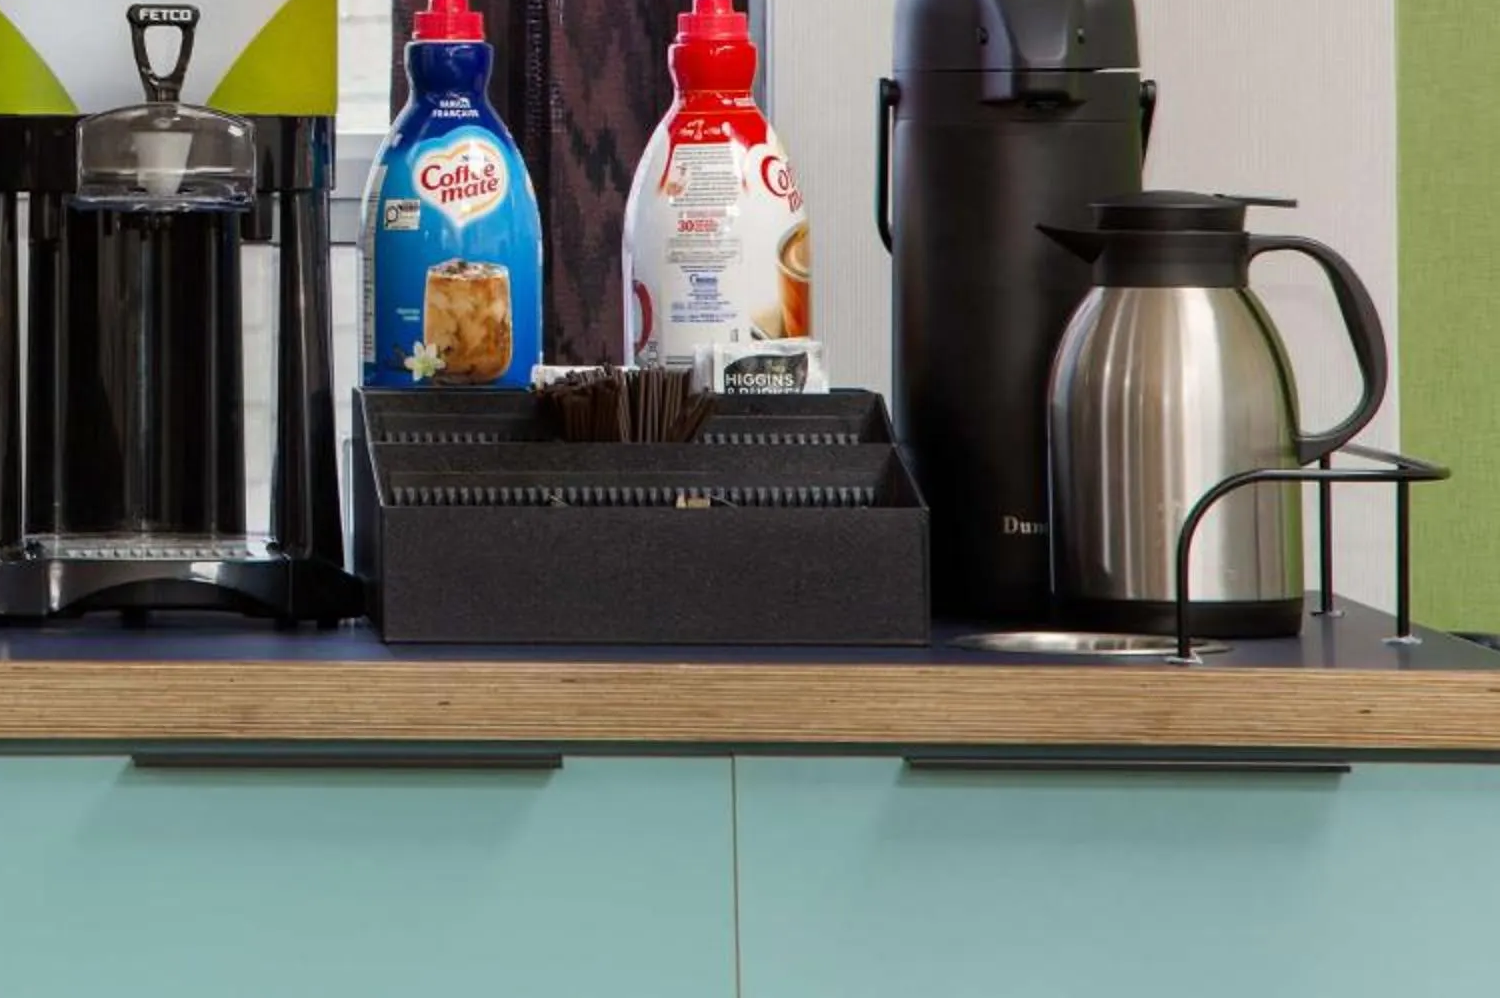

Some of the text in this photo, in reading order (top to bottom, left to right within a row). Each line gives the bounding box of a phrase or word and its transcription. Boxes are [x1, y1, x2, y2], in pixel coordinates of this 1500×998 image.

[139, 8, 191, 21] FETCO
[441, 179, 498, 204] mate
[725, 373, 794, 387] HIGGINS
